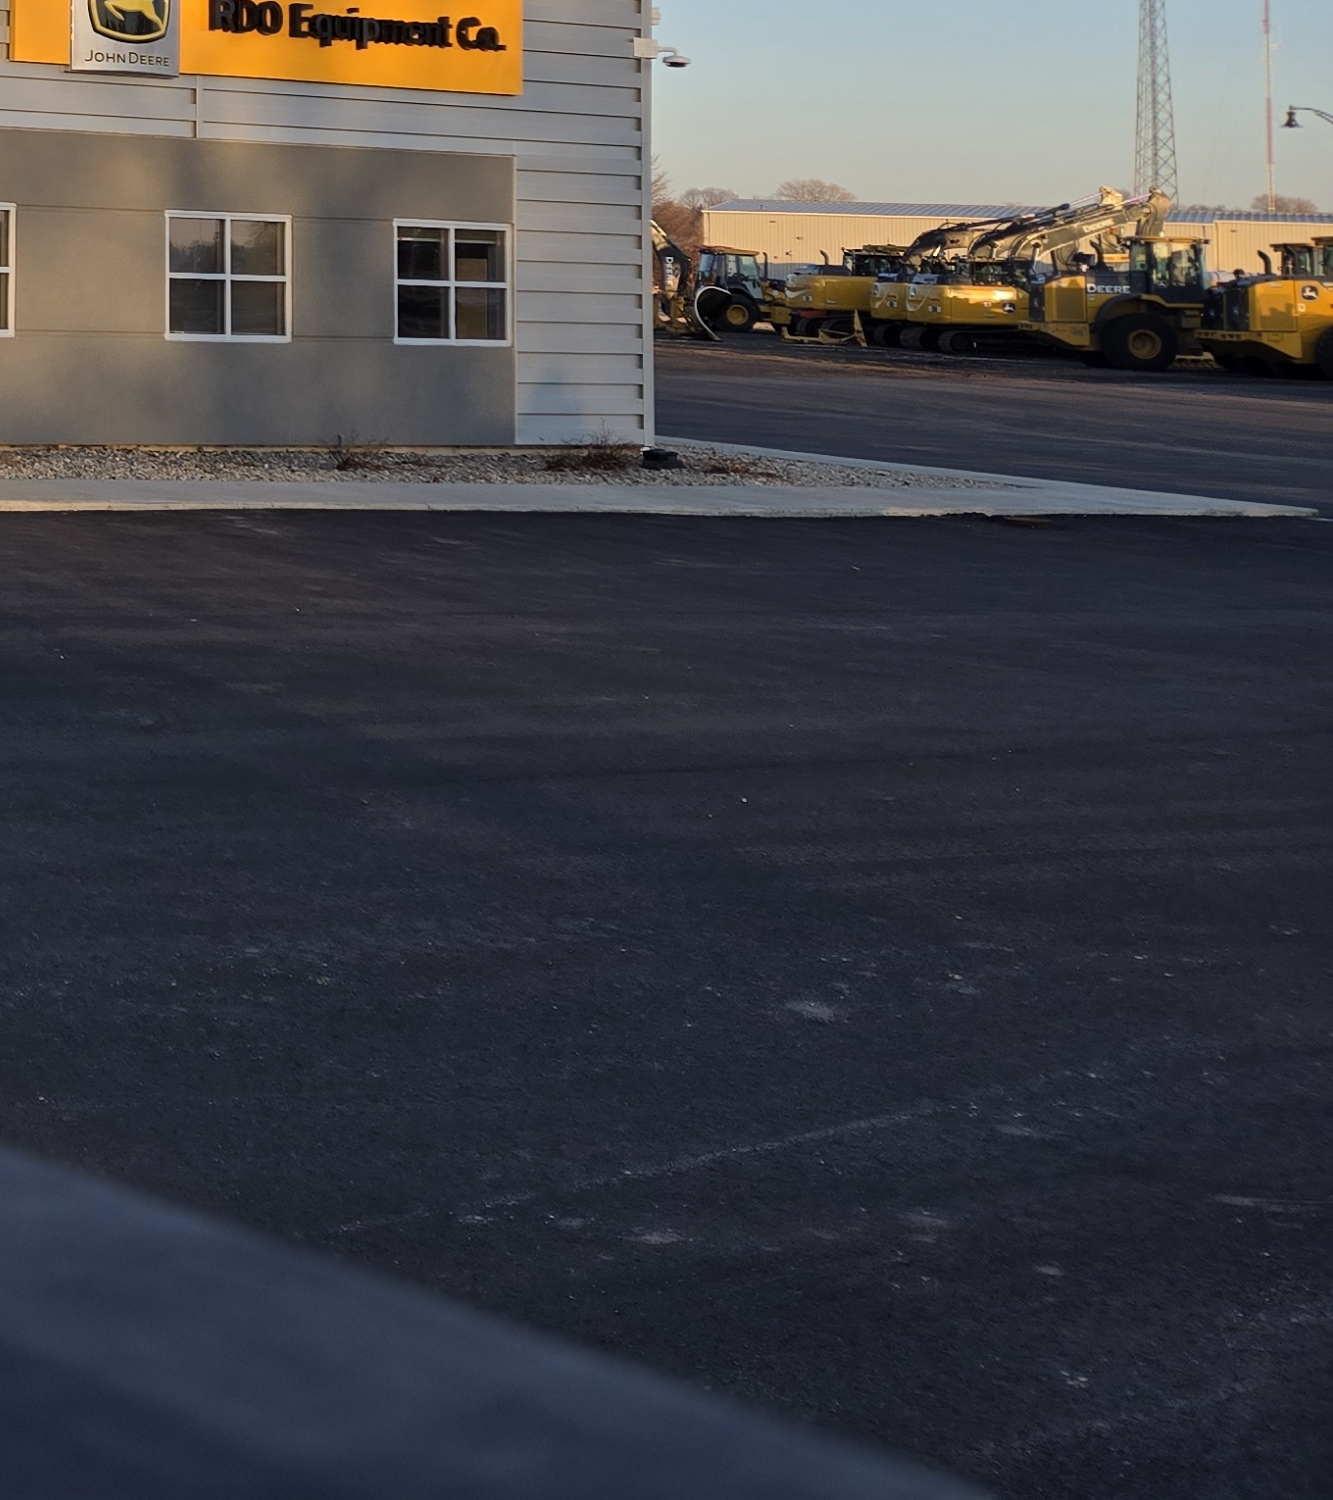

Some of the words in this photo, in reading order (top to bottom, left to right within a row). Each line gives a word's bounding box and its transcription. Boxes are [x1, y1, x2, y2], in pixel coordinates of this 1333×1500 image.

[288, 3, 453, 50] Equipment
[456, 16, 507, 51] Co.
[84, 50, 126, 63] JOHN
[128, 52, 170, 67] DEERE
[1086, 283, 1131, 294] DEERE
